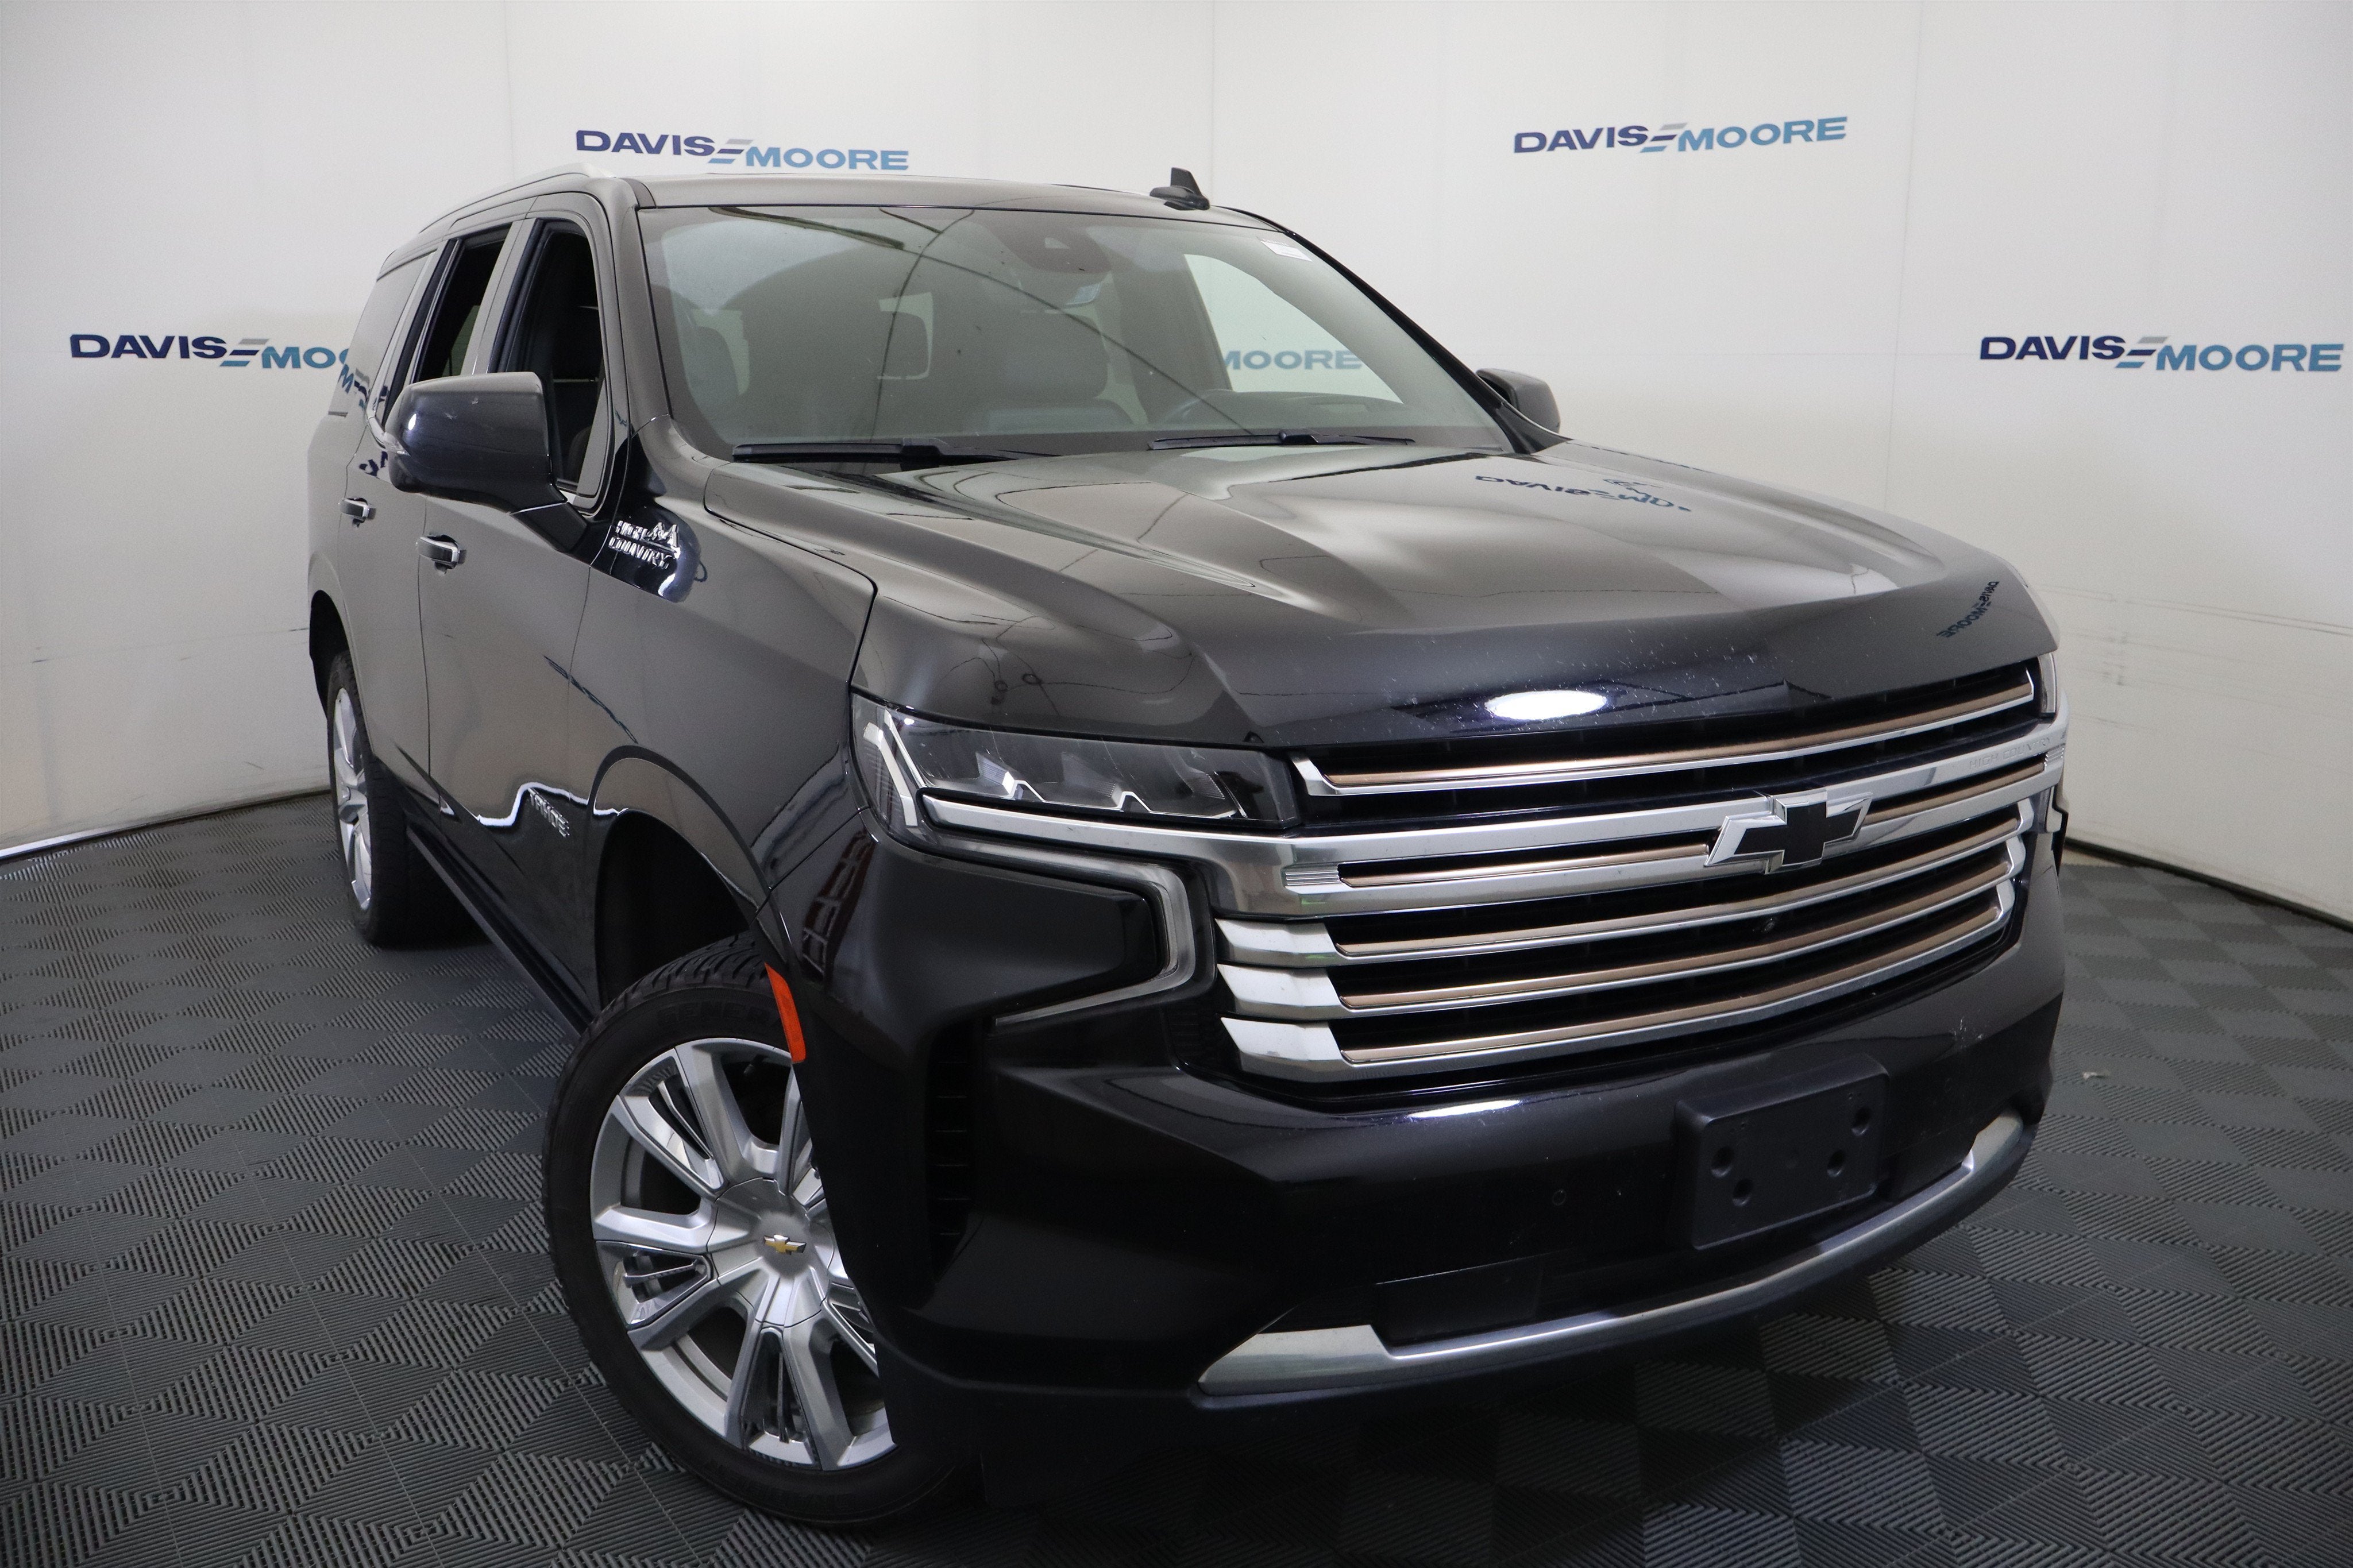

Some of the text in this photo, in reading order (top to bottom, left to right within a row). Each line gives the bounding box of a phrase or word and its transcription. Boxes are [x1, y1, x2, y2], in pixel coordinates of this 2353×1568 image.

[576, 130, 909, 171] DAVIS MOORE
[1513, 116, 1847, 153] DAVIS MOORE
[69, 334, 227, 360] DAVIS
[1979, 335, 2344, 372] DAVIS MOORE
